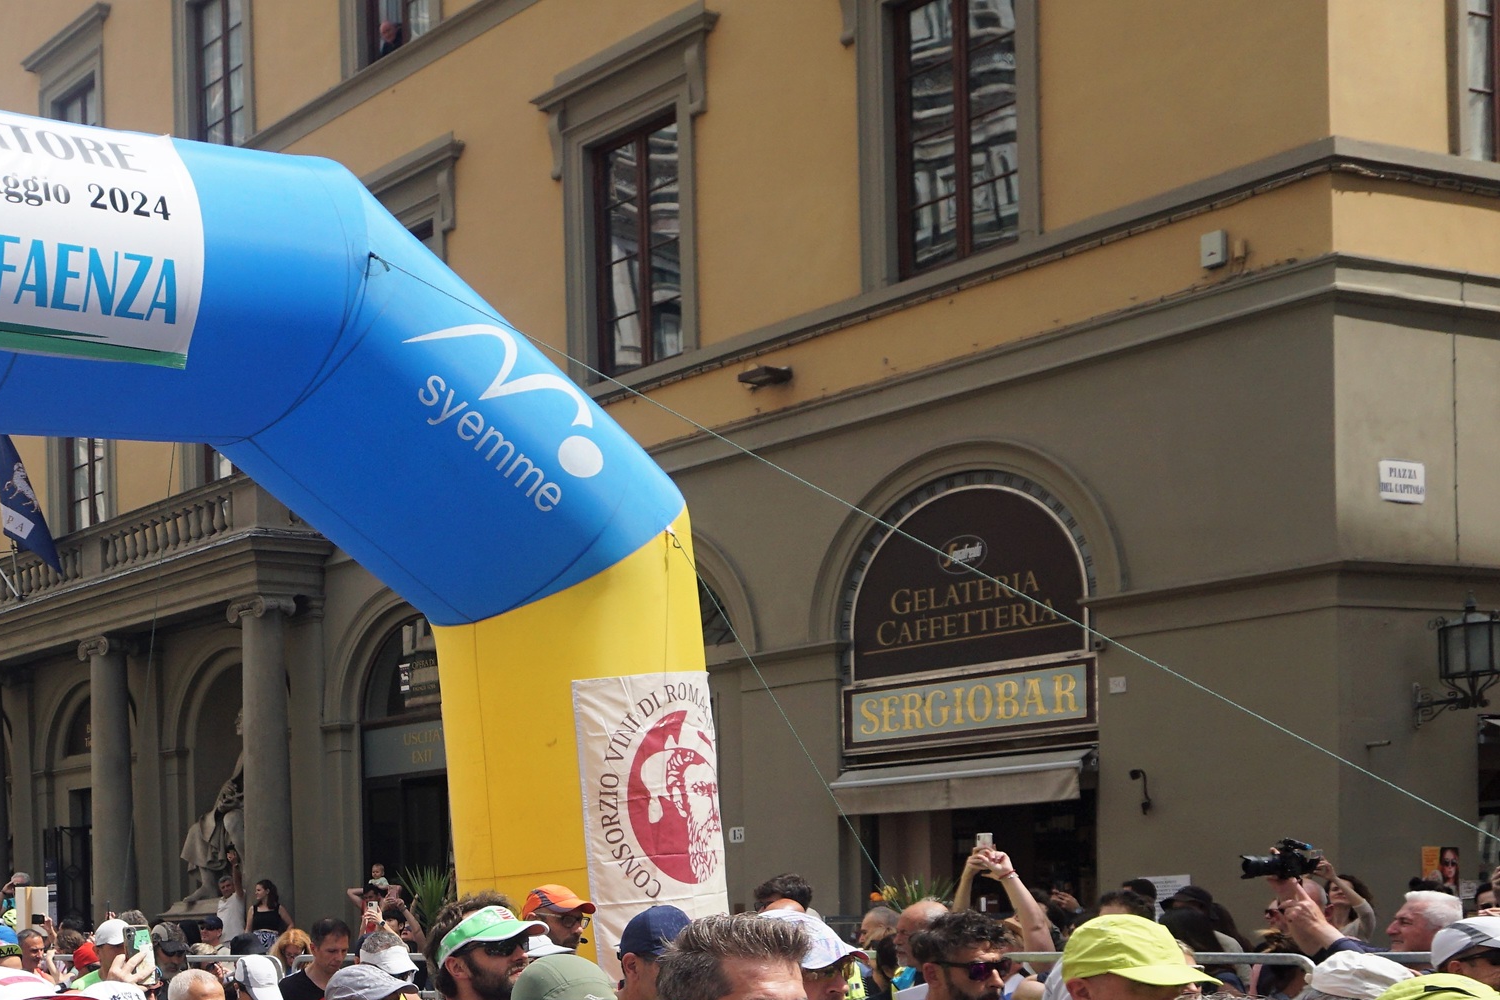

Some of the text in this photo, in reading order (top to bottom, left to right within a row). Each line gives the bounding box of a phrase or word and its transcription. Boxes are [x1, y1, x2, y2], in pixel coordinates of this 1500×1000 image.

[87, 182, 172, 222] 2024
[418, 375, 562, 512] syemme
[1380, 482, 1425, 495] DEL CAPITOLO
[1388, 467, 1417, 480] PIAZZA
[890, 570, 1040, 615] GELATERIA
[876, 598, 1059, 647] CAFFETTERIA
[637, 690, 663, 719] DI
[860, 673, 1080, 736] SERGIOBAR
[411, 749, 433, 764] EXIT
[603, 713, 641, 763] VINI
[599, 772, 662, 899] CONSORZIO
[731, 829, 743, 840] 15
